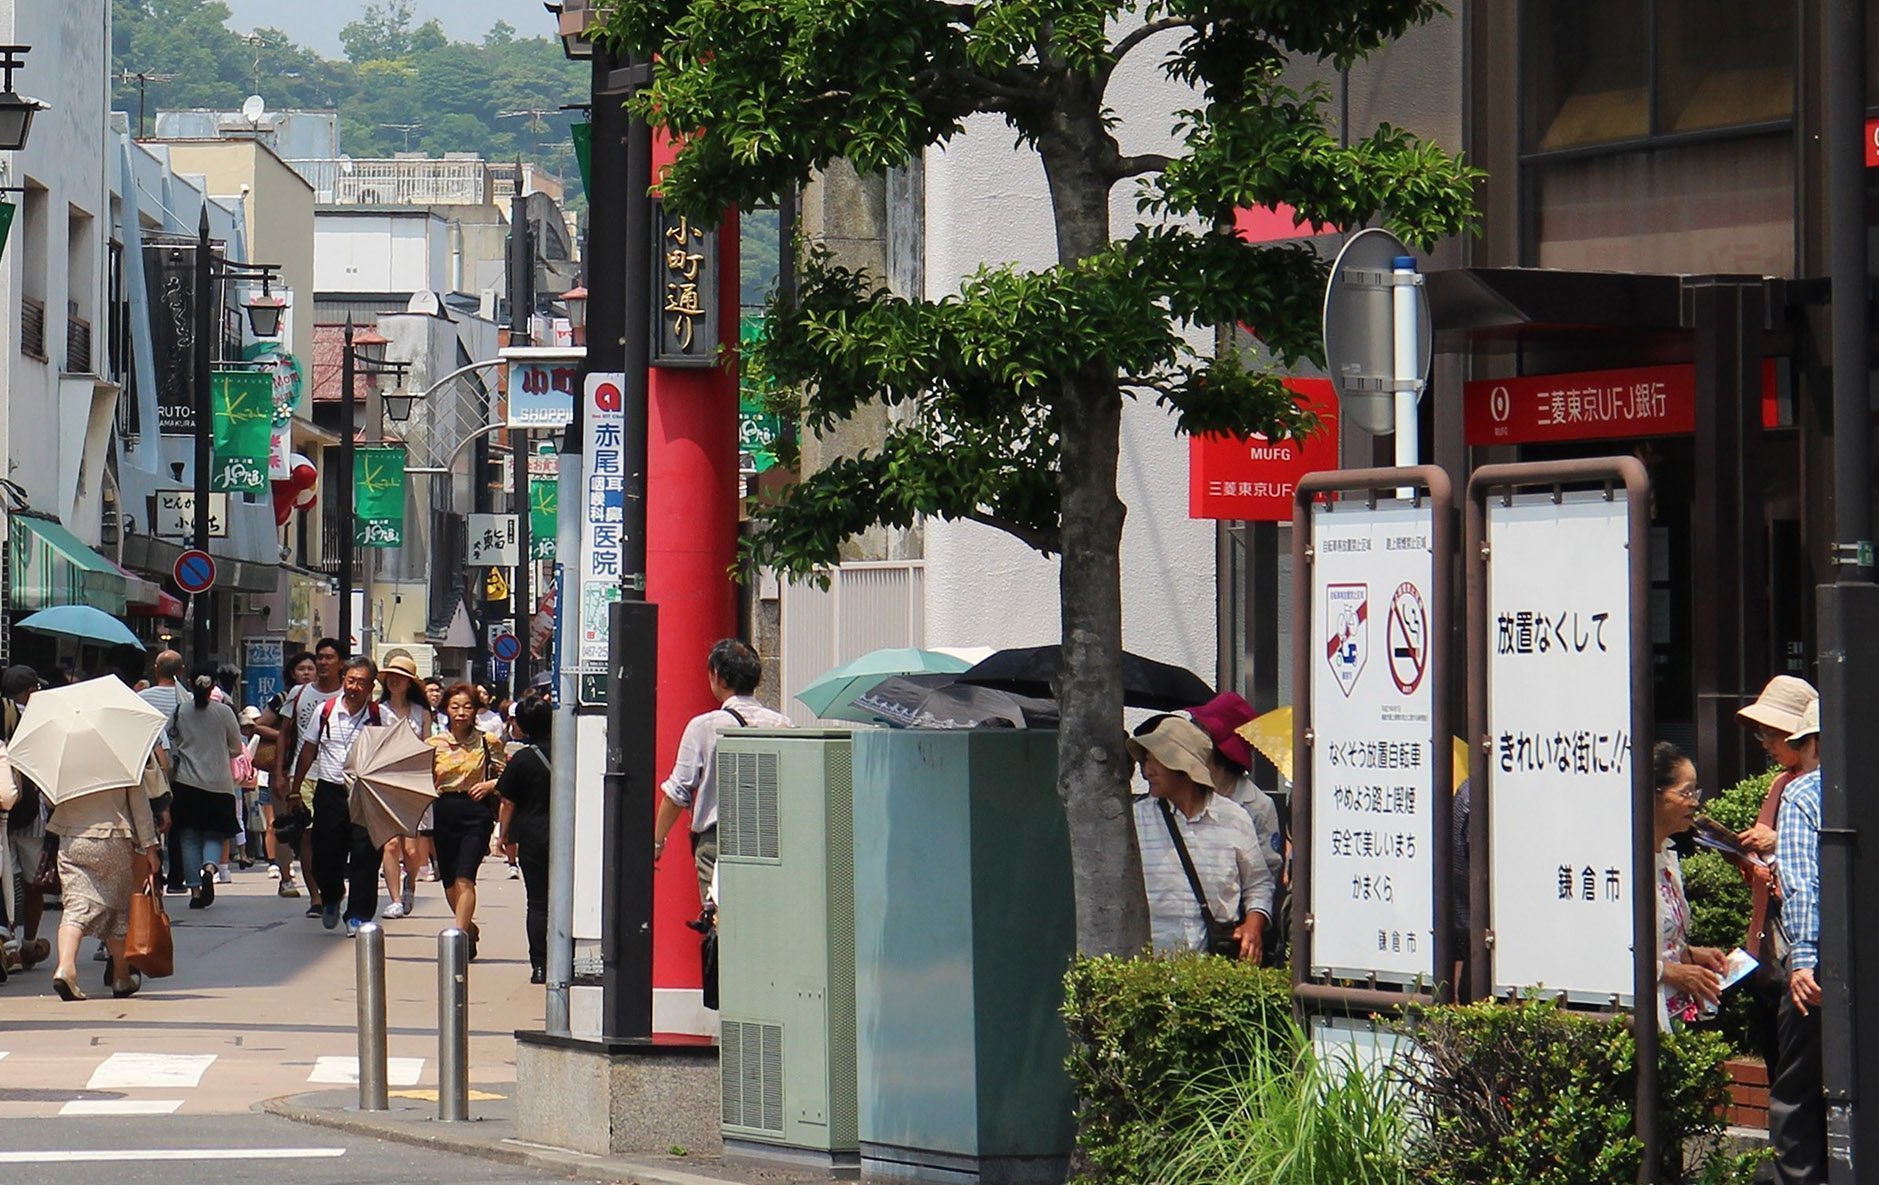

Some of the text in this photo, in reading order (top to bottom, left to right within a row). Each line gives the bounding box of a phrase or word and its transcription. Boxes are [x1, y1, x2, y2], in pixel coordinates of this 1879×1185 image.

[664, 215, 706, 352] 小町通り
[1536, 381, 1667, 426] 三菱東京UFJ銀行
[595, 422, 621, 474] 赤尾
[1250, 447, 1292, 462] MUFG
[1208, 480, 1296, 498] 三菱東京UF
[593, 525, 618, 576] 医院
[1498, 611, 1609, 655] 放置なくして
[1329, 740, 1421, 769] なくそう放置自転車
[1334, 784, 1417, 815] やめよう路上喫煙
[1331, 828, 1417, 859] 安全で美しいまち
[1351, 874, 1394, 903] かまくら
[1557, 865, 1621, 902] 鎌倉市
[1378, 928, 1418, 954] 鎌倉市
